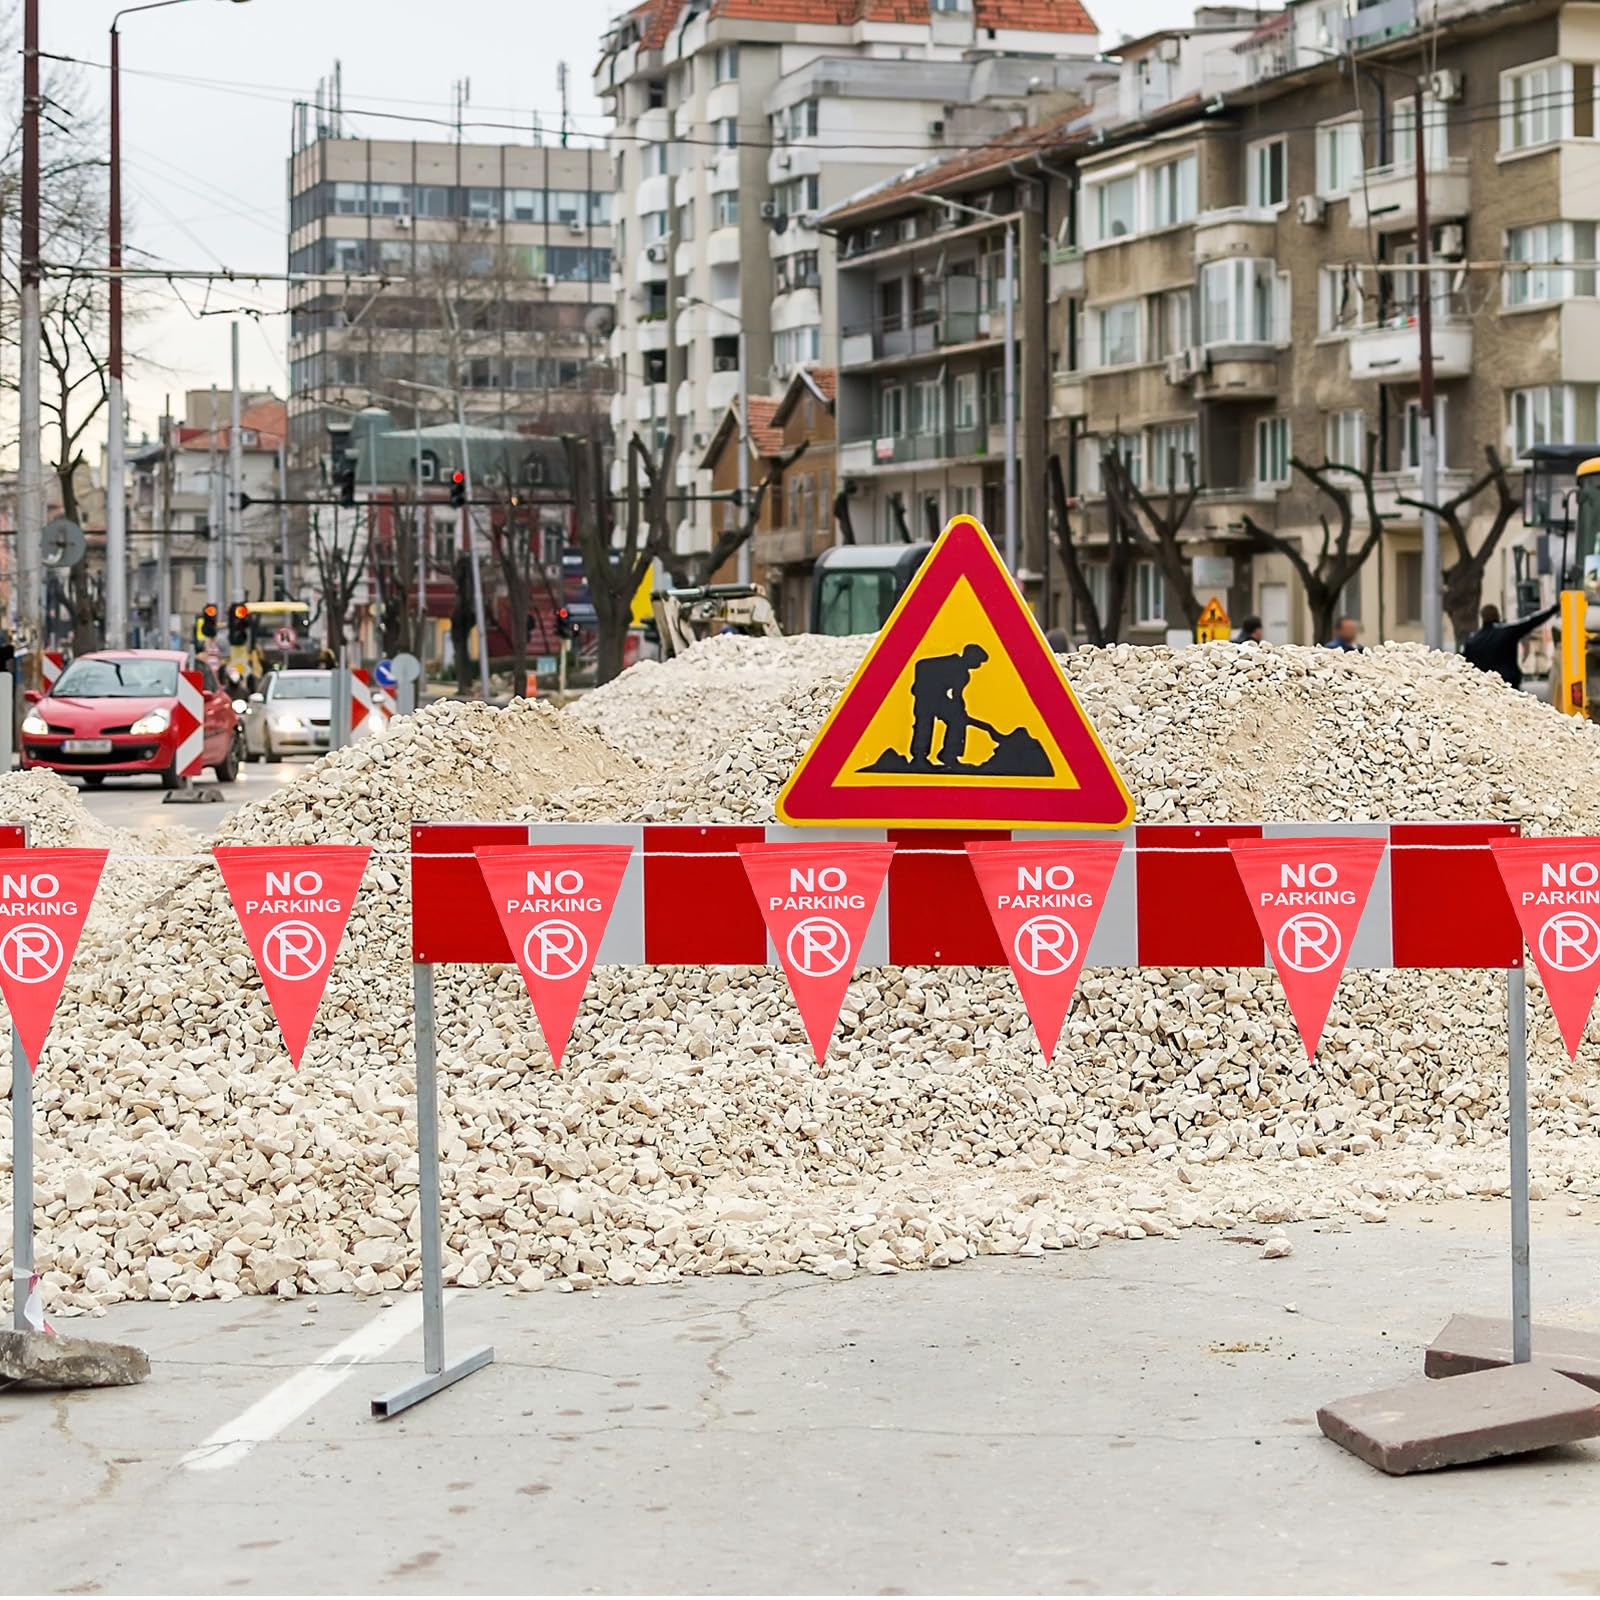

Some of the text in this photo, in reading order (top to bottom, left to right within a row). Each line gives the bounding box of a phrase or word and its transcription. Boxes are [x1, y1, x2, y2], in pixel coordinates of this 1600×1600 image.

[266, 871, 322, 896] NO
[528, 870, 583, 895] NO
[791, 868, 847, 892] NO
[1018, 866, 1074, 890] NO
[1281, 863, 1337, 888] NO
[1542, 862, 1598, 887] NO
[3, 874, 59, 898] NO
[246, 899, 341, 914] PARKING
[508, 898, 602, 913] PARKING
[770, 896, 865, 910] PARKING
[998, 894, 1092, 908] PARKING
[1261, 891, 1355, 906] PARKING
[1522, 890, 1600, 905] PARKIN
[0, 902, 78, 917] ARKING
